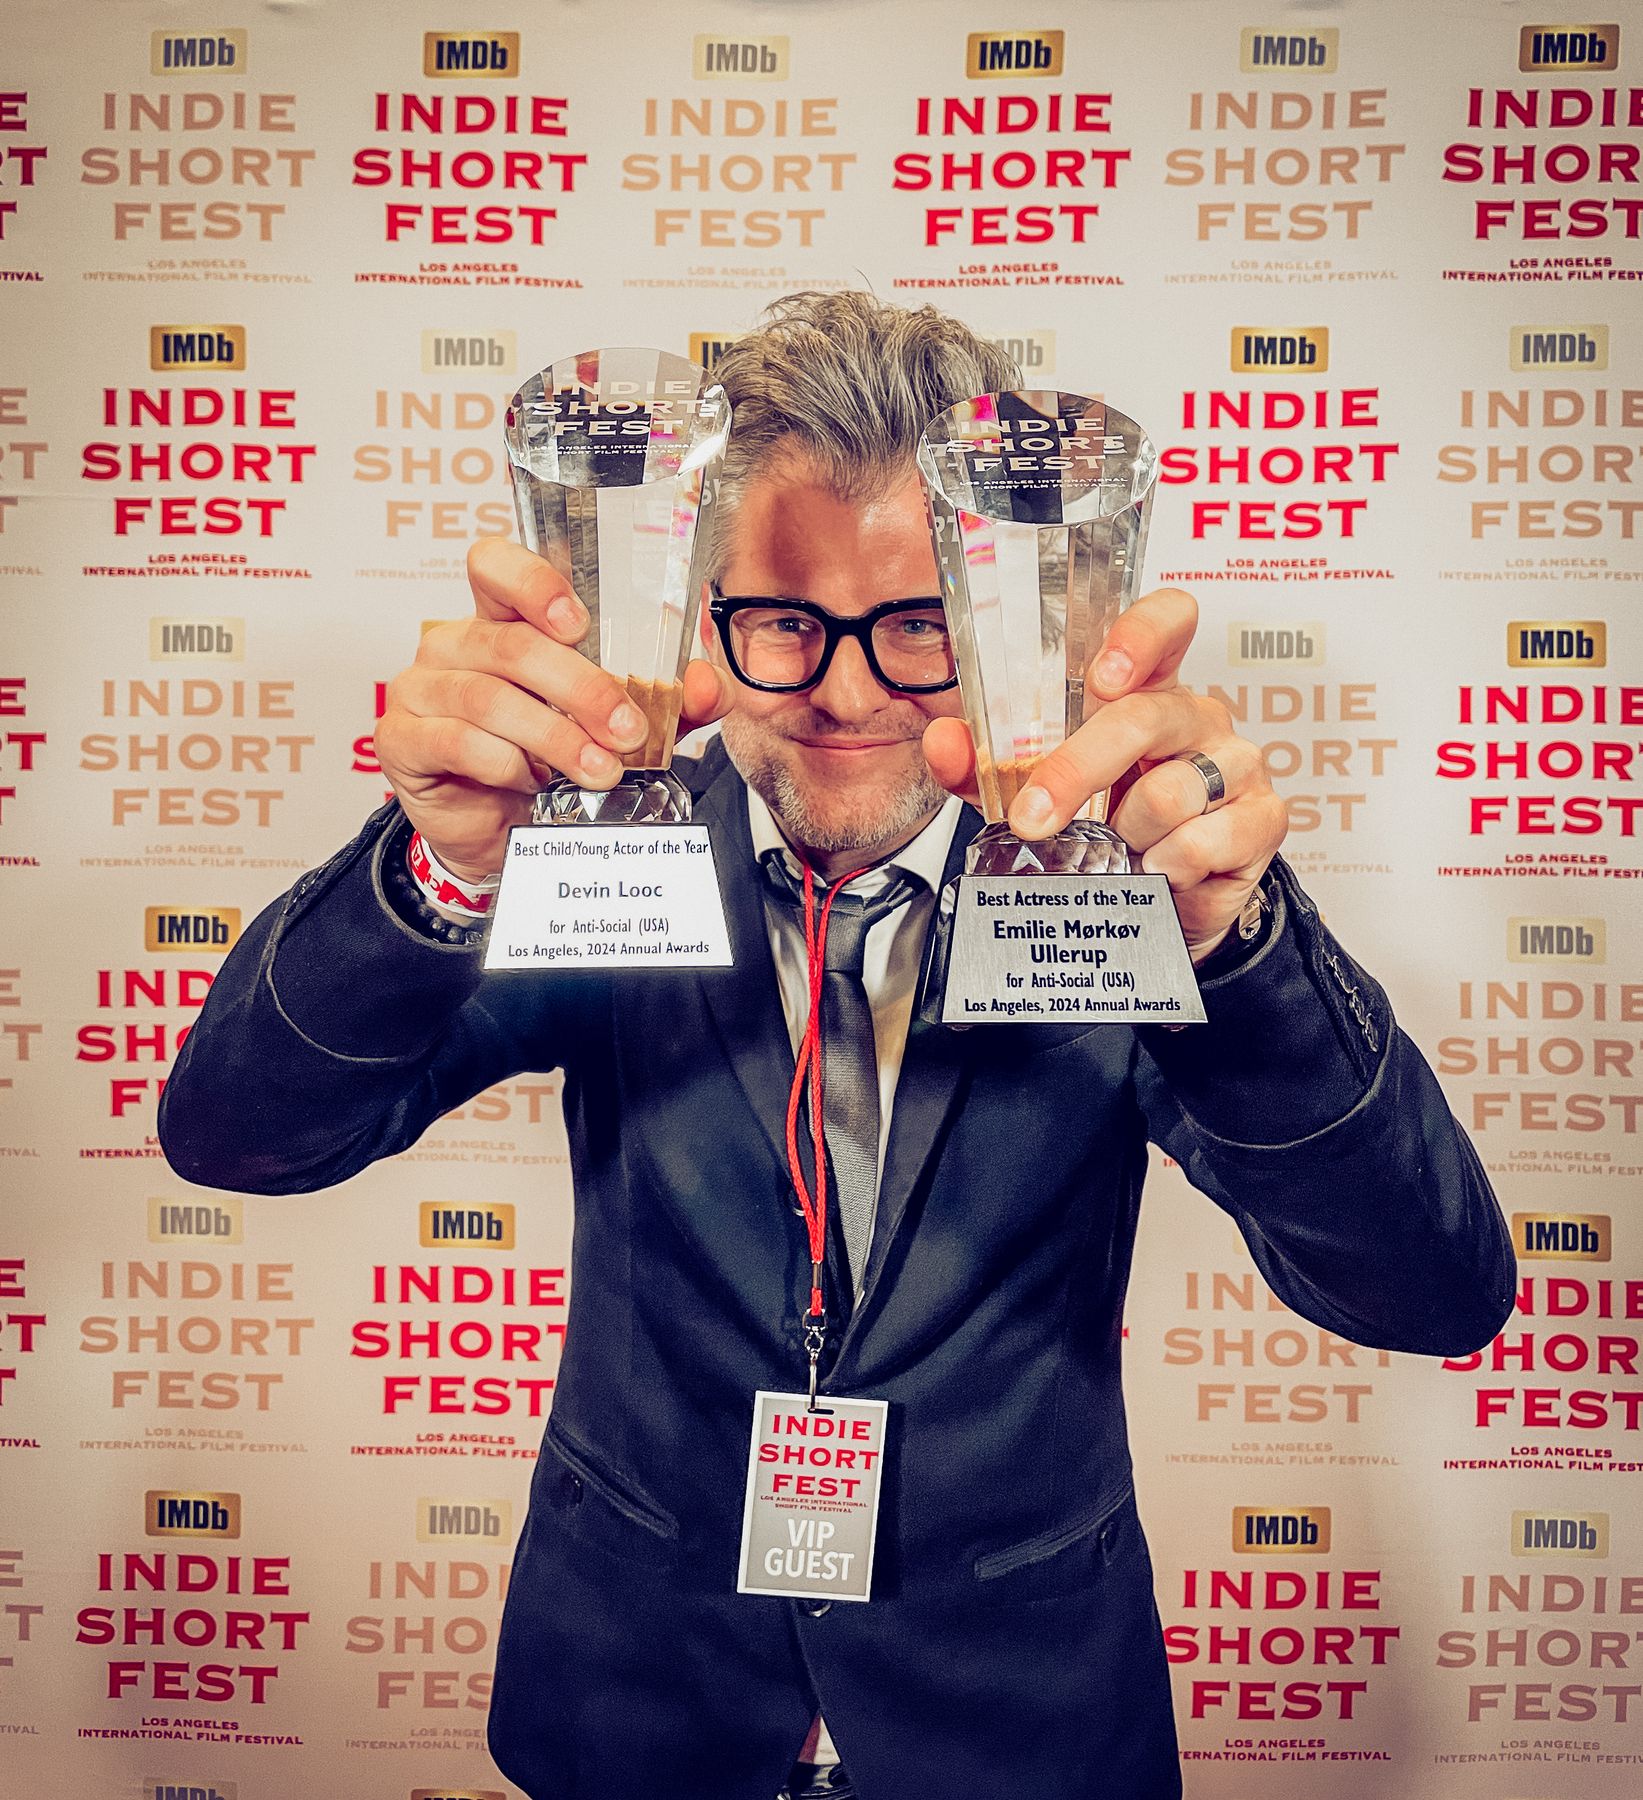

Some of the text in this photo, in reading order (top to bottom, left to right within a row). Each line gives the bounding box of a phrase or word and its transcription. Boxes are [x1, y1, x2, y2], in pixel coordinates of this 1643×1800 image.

[164, 38, 234, 67] IMDb
[436, 40, 507, 70] IMDb
[706, 43, 776, 73] IMDb
[979, 40, 1051, 70] IMDb
[1253, 36, 1326, 65] IMDb
[1532, 33, 1606, 63] IMDb
[104, 93, 295, 131] INDIE
[376, 93, 567, 136] INDIE
[645, 98, 837, 137] INDIE
[918, 94, 1112, 135] INDIE
[1190, 89, 1387, 130] INDIE
[81, 147, 315, 187] SHORT
[353, 148, 587, 191] SHORT
[622, 154, 856, 192] SHORT
[893, 150, 1131, 191] SHORT
[1166, 144, 1406, 185] SHORT
[114, 202, 284, 240] FEST
[386, 204, 556, 245] FEST
[654, 209, 825, 247] FEST
[926, 205, 1098, 246] FEST
[1199, 201, 1373, 241] FEST
[420, 262, 518, 273] LOS ANGELES
[959, 262, 1059, 275] LOS ANGELES
[1443, 270, 1603, 282] INTERNATIONAL FILM
[1510, 257, 1612, 268] LOS ANGELES
[355, 275, 584, 288] INTERNATIONAL FILM FESTIVAL
[893, 275, 1124, 288] INTERNATIONAL FILM FESTIVAL
[162, 334, 233, 363] IMDb
[1244, 336, 1316, 364] IMDb
[553, 380, 691, 396] INDIE
[104, 388, 295, 427] INDIE
[532, 400, 706, 416] SHORT
[1183, 389, 1378, 429] INDIE
[554, 420, 684, 436] FEST
[960, 418, 1104, 434] INDIE
[946, 436, 1123, 453] SHORT
[82, 443, 315, 482] SHORT
[974, 455, 1106, 472] FEST
[1160, 444, 1399, 484] SHORT
[115, 498, 285, 536] FEST
[1193, 499, 1367, 539] FEST
[82, 567, 312, 578] INTERNATIONAL FILM FESTIVAL
[149, 554, 247, 564] LOS ANGELES
[1227, 557, 1327, 568] LOS ANGELES
[1160, 569, 1394, 581] INTERNATIONAL FILM FESTIVAL
[163, 624, 232, 653] IMDb
[1521, 630, 1594, 659] IMDb
[103, 680, 294, 719] INDIE
[81, 734, 314, 772] SHORT
[113, 788, 283, 827] FEST
[515, 840, 709, 859] Best Child/Young Actor of the Year
[1506, 854, 1607, 864] LOS ANGELES
[1438, 866, 1599, 878] INTERNATIONAL FILM
[559, 881, 663, 898] Devin Looc
[977, 890, 1155, 906] Best Actress of the Year
[158, 915, 228, 944] IMDb
[550, 918, 669, 935] for Anti-Social (USA)
[994, 920, 1141, 939] Emilie Mørkøv
[508, 941, 709, 959] Los Angeles, 2024 Annual Awards
[1031, 944, 1108, 968] Ullerup
[1006, 972, 1135, 991] for Anti-Social (USA)
[965, 997, 1181, 1015] Los Angeles, 2024 Annual Awards
[160, 1206, 231, 1236] IMDb
[433, 1211, 502, 1241] IMDb
[1526, 1222, 1599, 1253] IMDb
[102, 1261, 293, 1300] INDIE
[80, 1316, 314, 1355] SHORT
[113, 1371, 283, 1410] FEST
[1199, 1385, 1372, 1423] FEST
[416, 1433, 515, 1444] LOS ANGELES
[773, 1415, 871, 1440] INDIE
[351, 1446, 506, 1457] INTERNATIONAL FILM
[759, 1444, 879, 1470] SHORT
[1444, 1460, 1603, 1471] INTERNATIONAL FILM
[1511, 1447, 1613, 1458] LOS ANGELES
[773, 1474, 861, 1498] FEST
[158, 1499, 228, 1530] IMDb
[776, 1496, 808, 1504] ANGELES
[811, 1499, 868, 1508] INTERNATIONAL
[788, 1518, 835, 1549] VIP
[1246, 1516, 1318, 1545] IMDb
[99, 1554, 289, 1595] INDIE
[764, 1547, 854, 1581] GUEST
[1184, 1571, 1380, 1610] INDIE
[77, 1608, 309, 1650] SHORT
[1161, 1626, 1400, 1668] SHORT
[108, 1662, 277, 1703] FEST
[1192, 1682, 1367, 1720] FEST
[78, 1729, 303, 1745] INTERNATIONAL FILM FESTIVAL
[142, 1718, 239, 1731] LOS ANGELES
[1225, 1739, 1326, 1748] LOS ANGELES
[1283, 1751, 1392, 1761] FILM FESTIVAL
